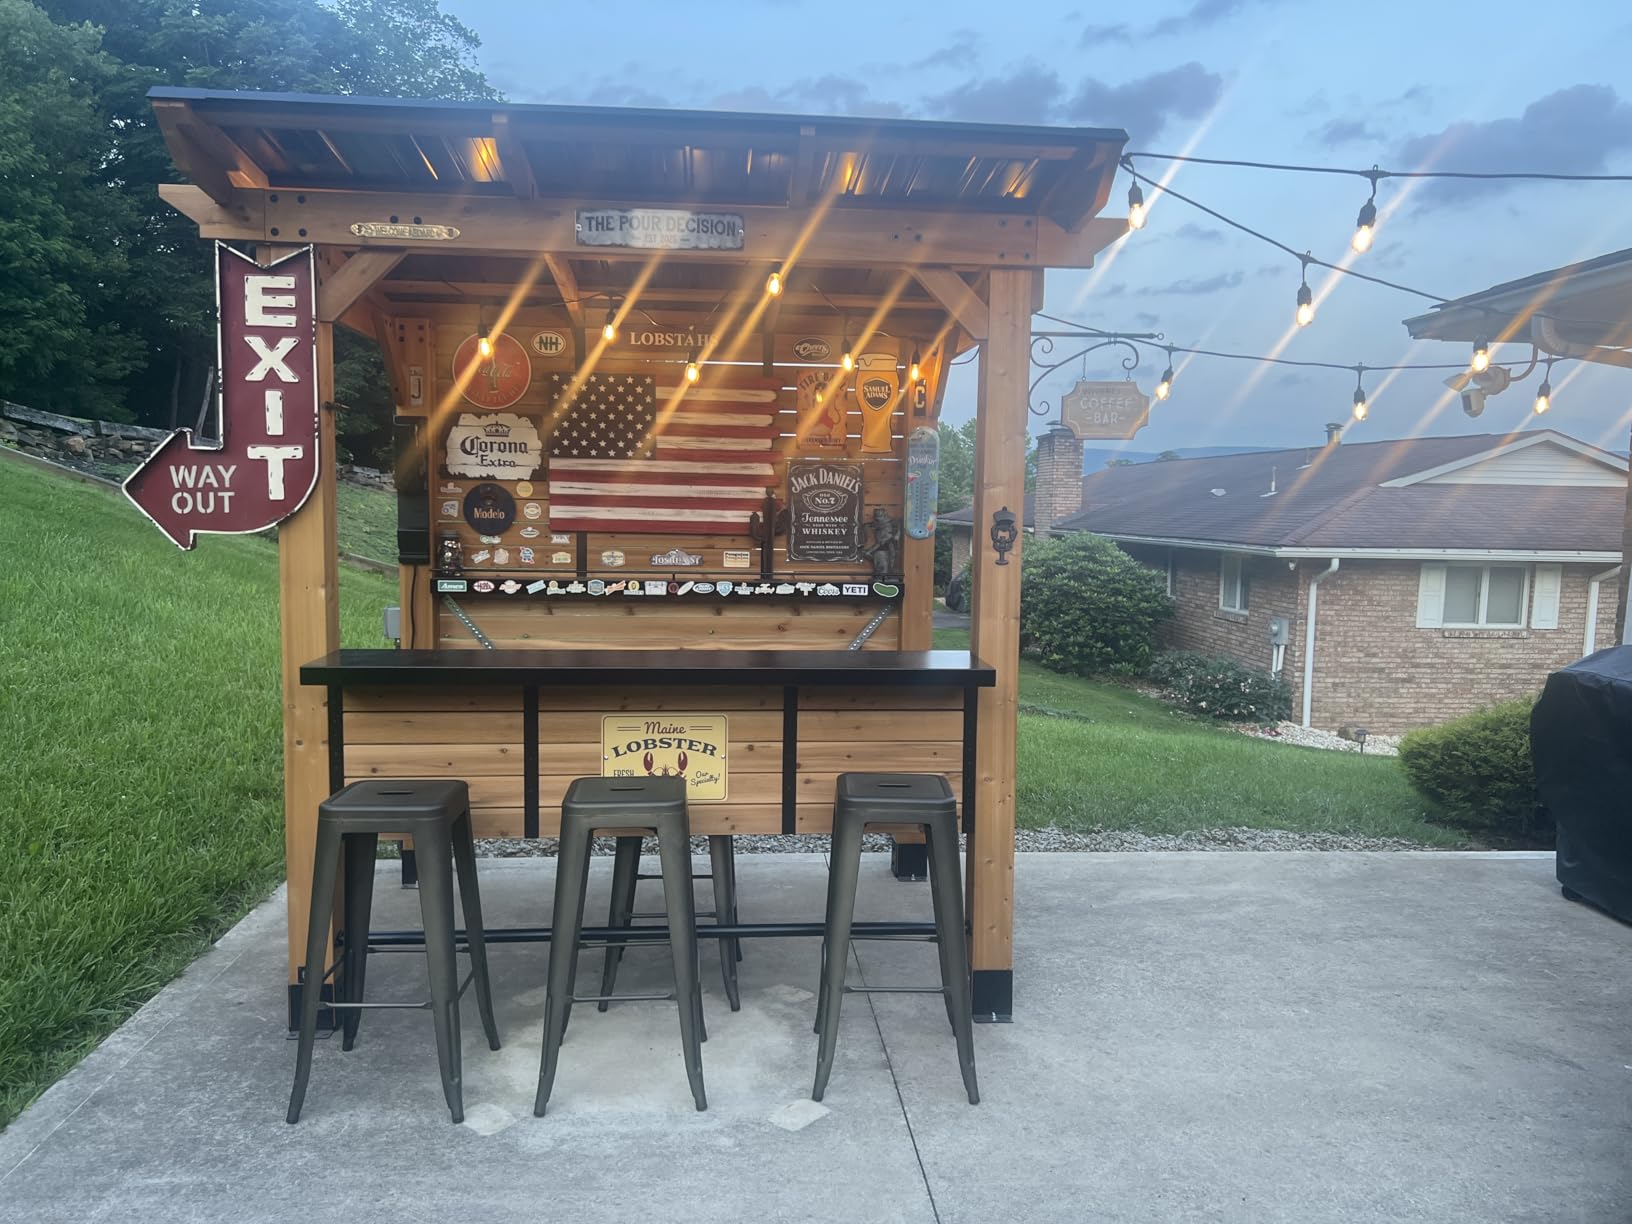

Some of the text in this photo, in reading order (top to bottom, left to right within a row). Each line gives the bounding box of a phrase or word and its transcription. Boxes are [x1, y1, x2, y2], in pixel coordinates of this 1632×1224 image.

[585, 215, 736, 236] THE POUR DECISION
[538, 336, 559, 351] NH
[244, 275, 303, 500] EXIT
[864, 385, 891, 394] SAMUEL
[866, 392, 889, 400] ADAMS
[1094, 412, 1119, 425] BAR
[460, 435, 529, 458] Corona
[480, 454, 518, 468] Extra
[169, 464, 238, 489] WAY
[791, 467, 863, 495] JACK DANIEL'S
[171, 491, 236, 514] OUT
[473, 507, 506, 520] Modelo
[801, 512, 849, 523] Tennessee
[802, 528, 848, 536] WHISKEY
[844, 585, 867, 594] YETI
[644, 721, 687, 735] Maine
[611, 737, 718, 758] LOBSTER
[695, 770, 708, 779] Our
